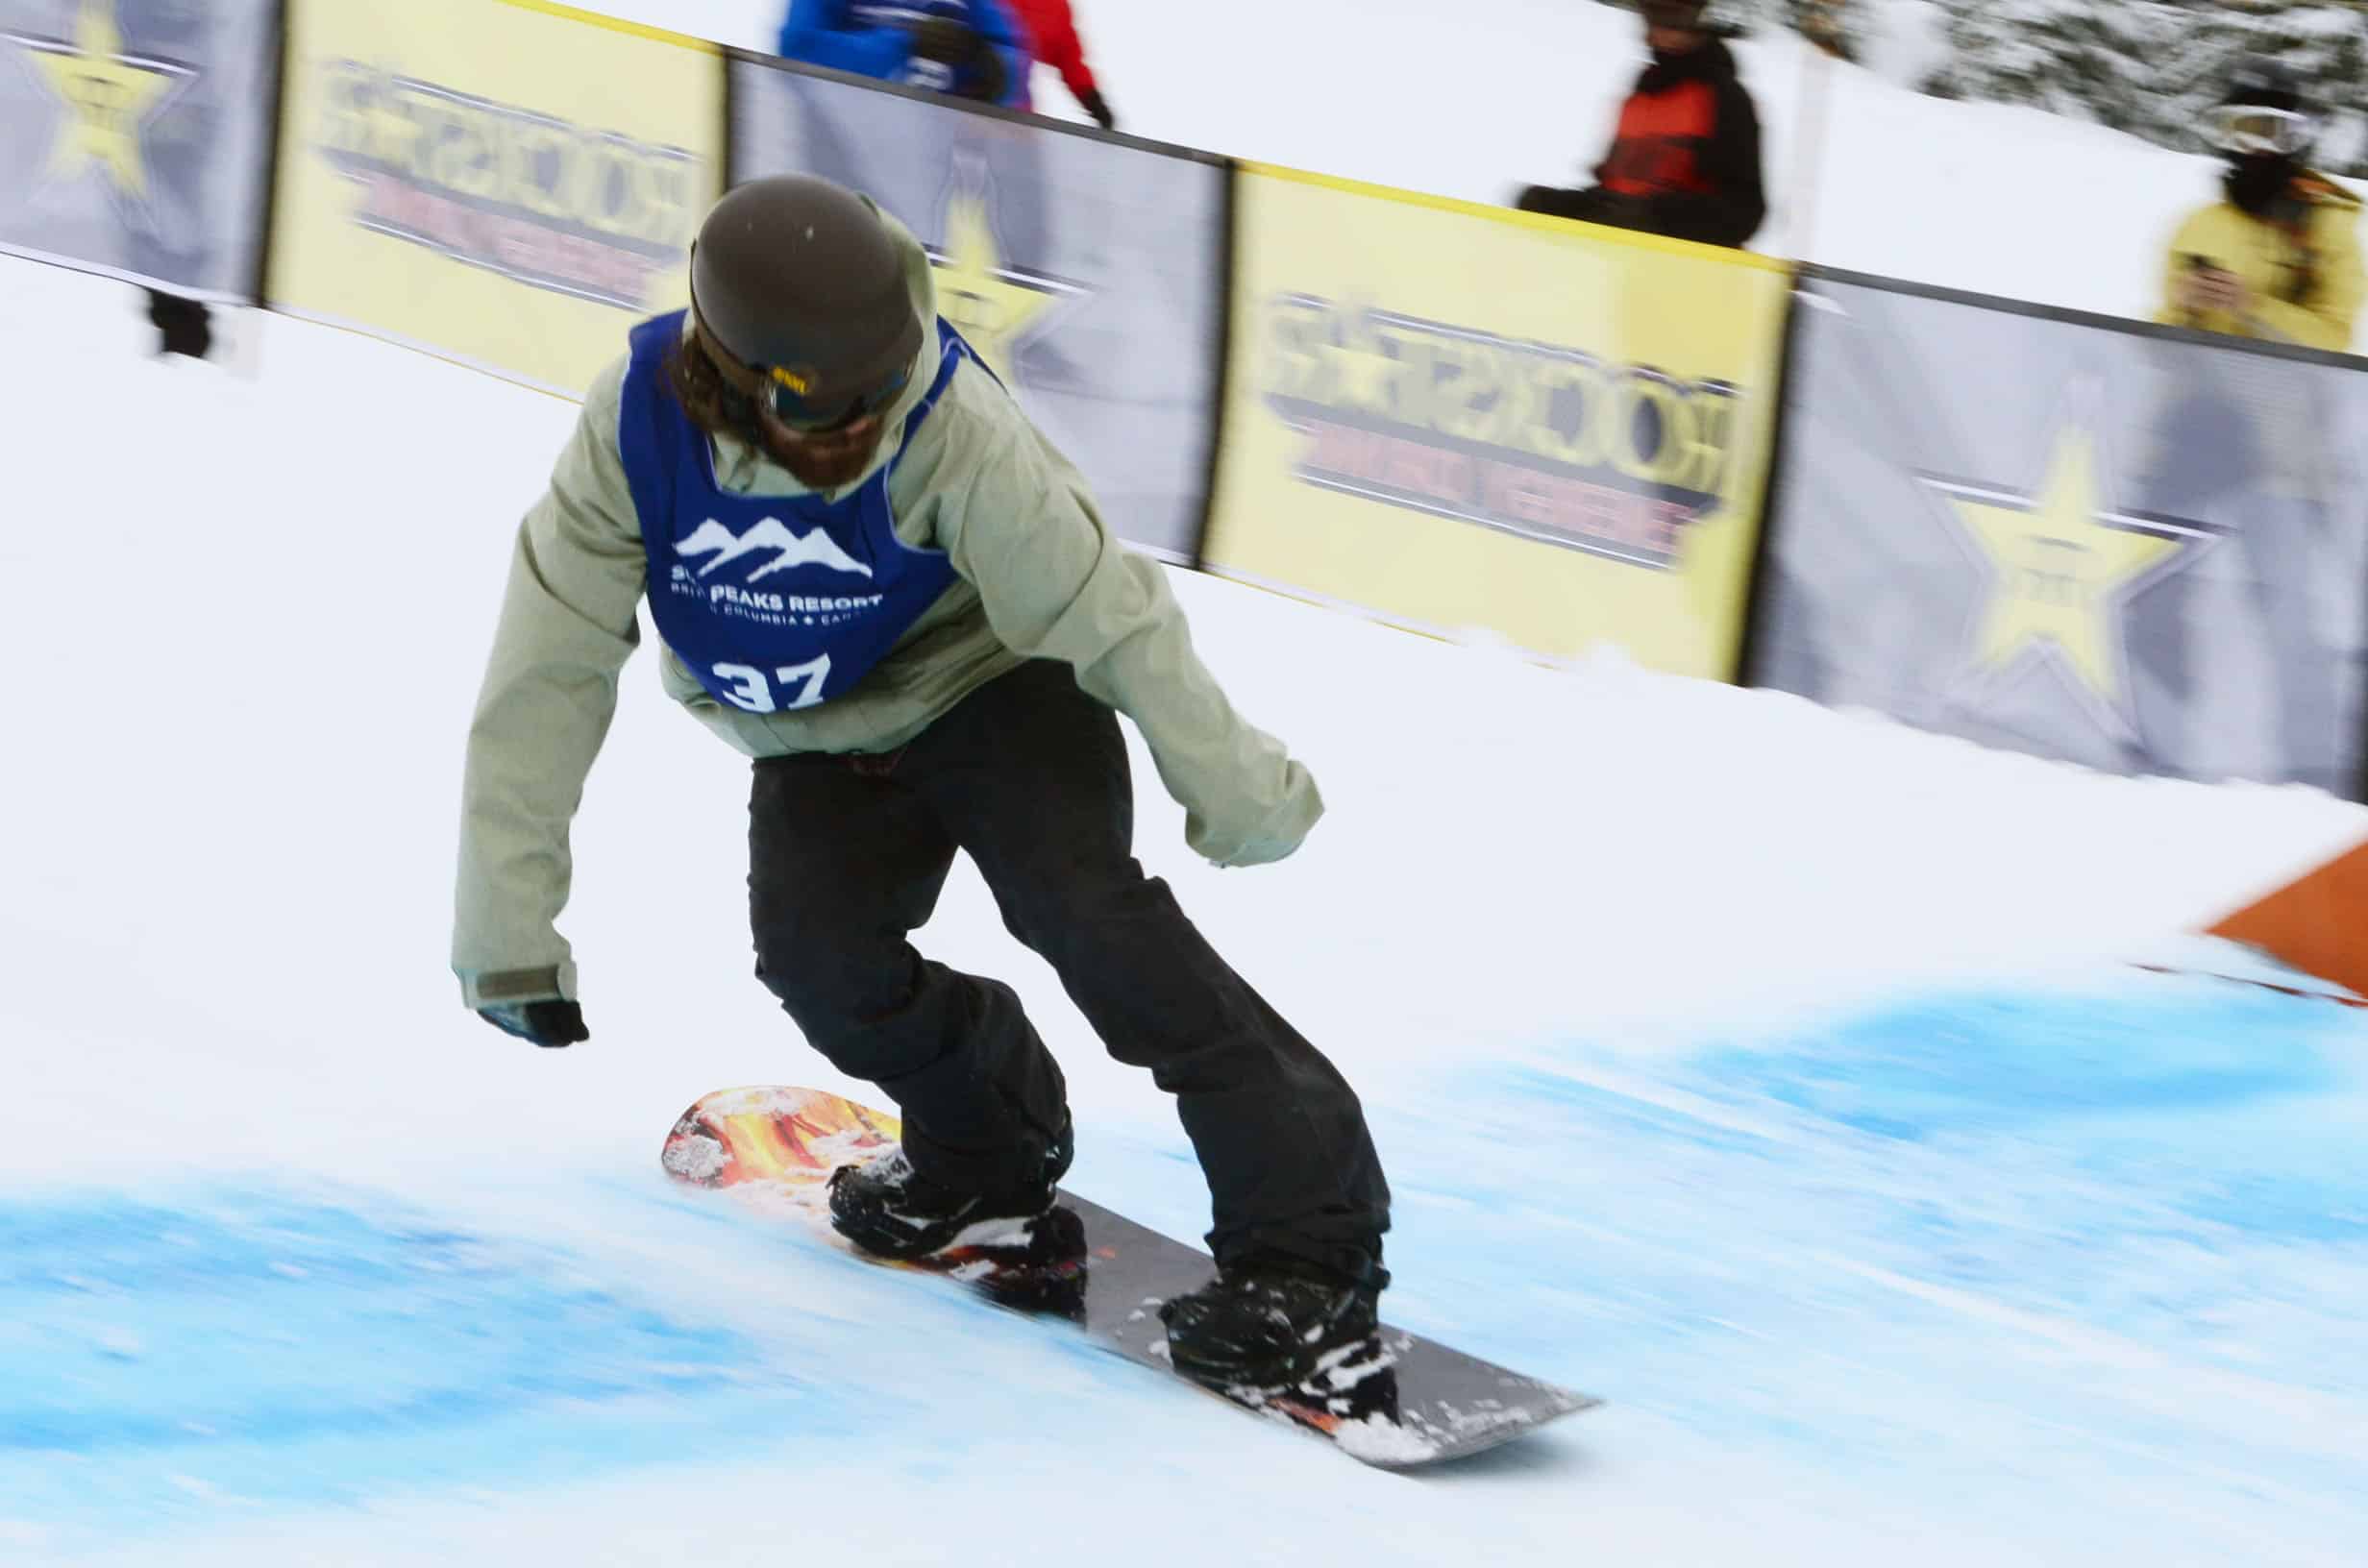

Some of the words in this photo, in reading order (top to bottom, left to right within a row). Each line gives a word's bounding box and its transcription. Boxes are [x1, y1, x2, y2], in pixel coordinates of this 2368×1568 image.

[710, 584, 783, 612] PEAKS
[789, 594, 883, 612] RESORT
[724, 602, 798, 625] COLUMBIA
[711, 652, 831, 714] 37
